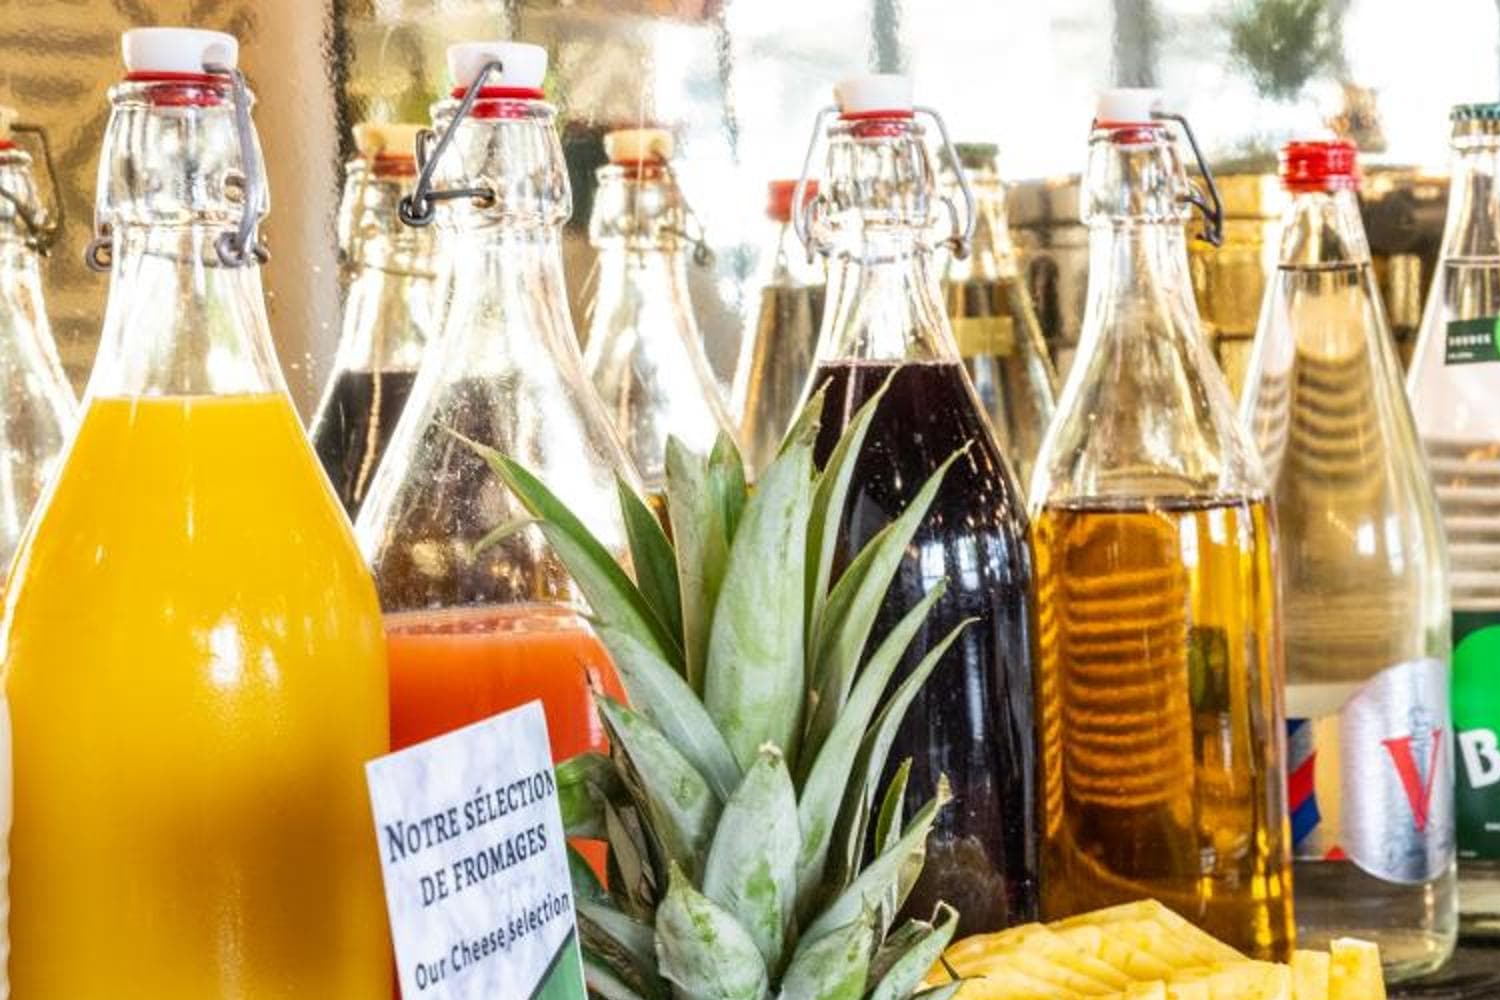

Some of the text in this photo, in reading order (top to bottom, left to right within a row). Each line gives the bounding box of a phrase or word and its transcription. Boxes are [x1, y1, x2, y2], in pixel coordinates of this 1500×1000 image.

[385, 807, 462, 864] NOTRE
[420, 823, 547, 908] DE FROMAGES
[415, 892, 571, 991] Our Cheese selection
